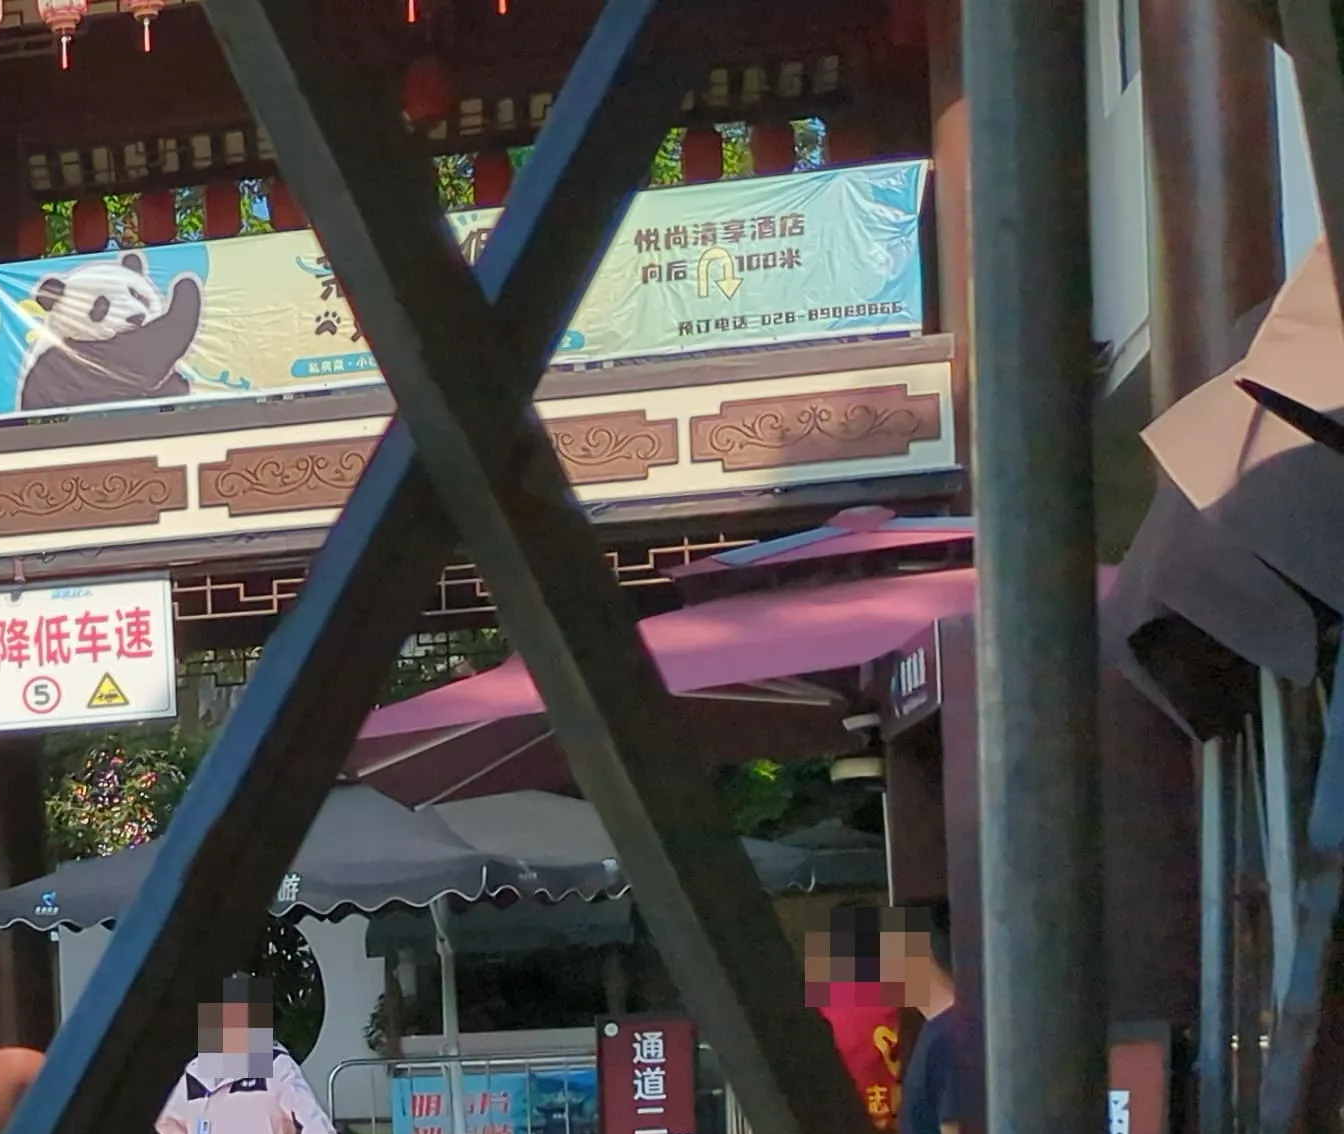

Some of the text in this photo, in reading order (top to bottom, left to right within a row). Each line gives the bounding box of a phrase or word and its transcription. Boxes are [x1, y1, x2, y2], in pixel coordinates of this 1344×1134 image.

[642, 260, 687, 284] 向后
[34, 684, 50, 706] 5
[632, 1031, 668, 1134] 通道二
